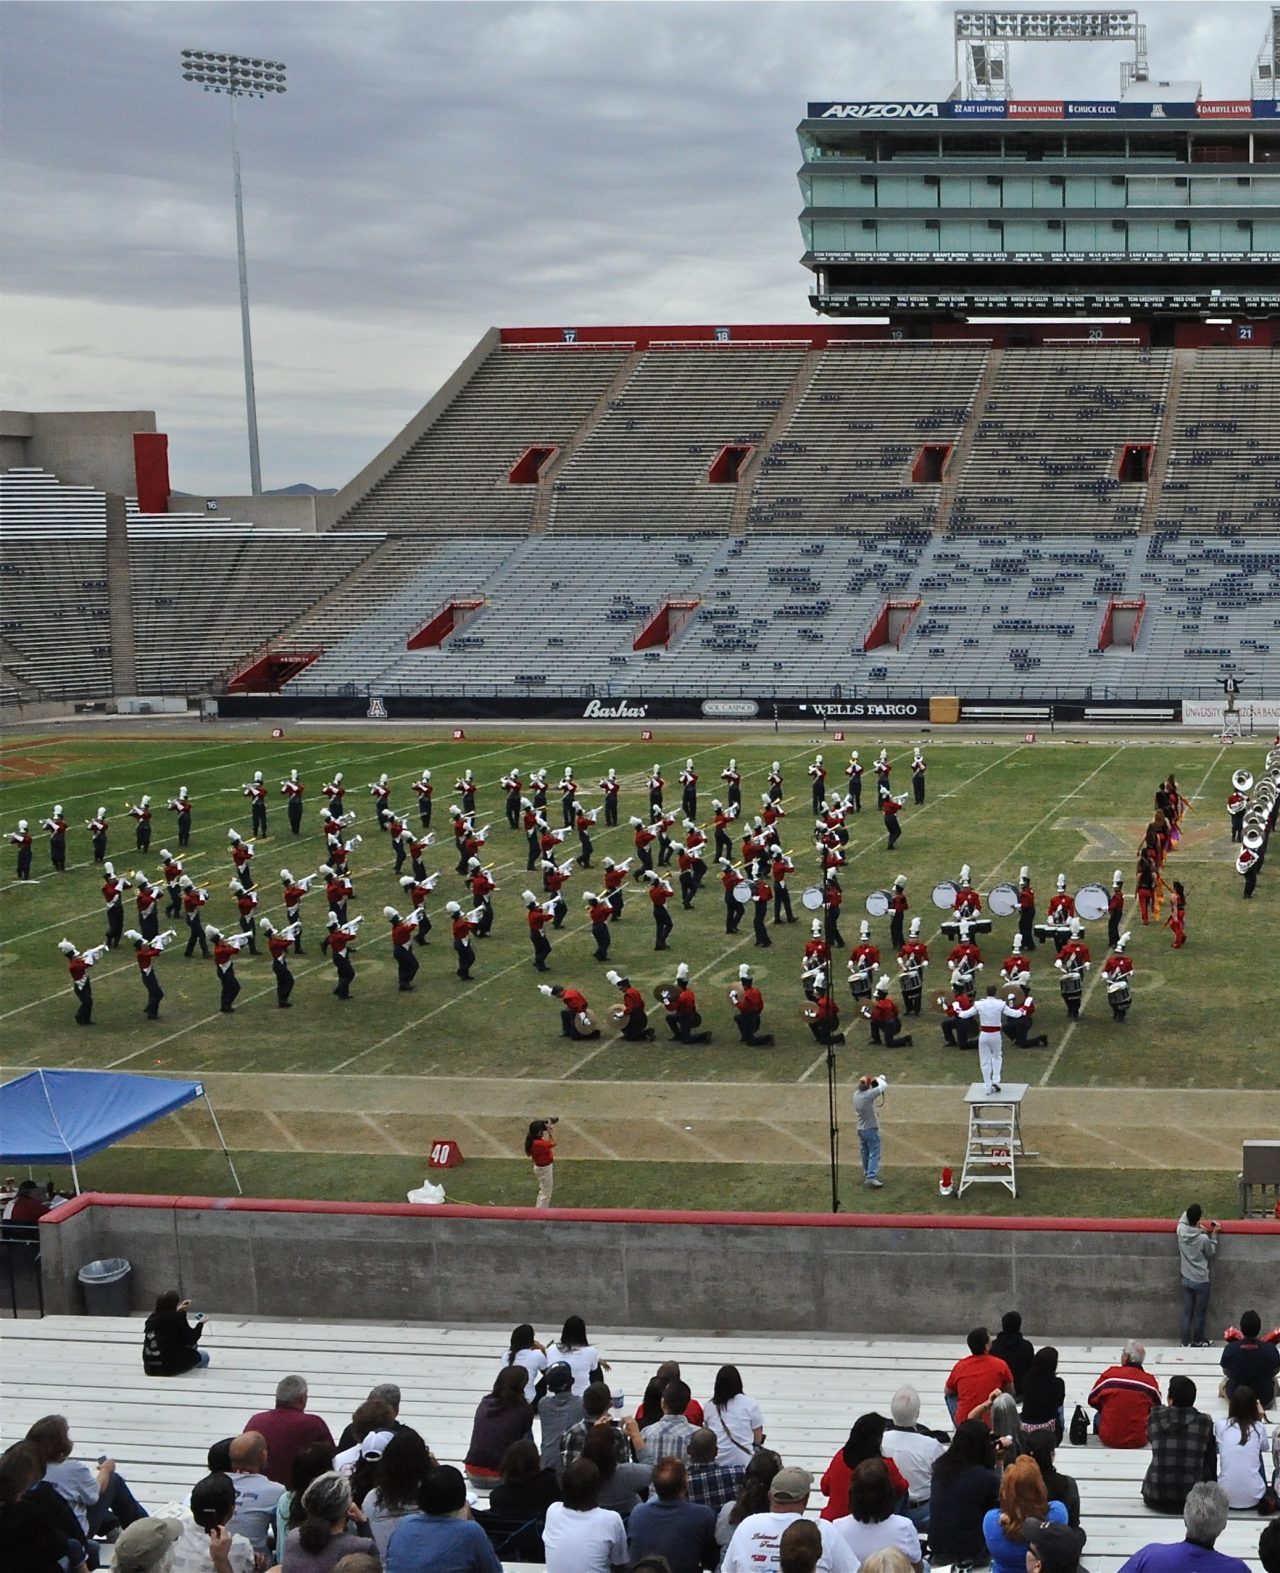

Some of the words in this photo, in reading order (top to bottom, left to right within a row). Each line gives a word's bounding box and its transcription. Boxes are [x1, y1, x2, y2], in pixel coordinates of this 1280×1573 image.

[821, 104, 938, 118] ARIZONA
[954, 104, 962, 113] 22
[1069, 104, 1074, 113] 6
[565, 334, 575, 342] 17
[717, 332, 728, 341] 18
[892, 332, 902, 340] 19
[1089, 330, 1102, 338] 20
[1240, 329, 1251, 339] 21
[207, 501, 216, 510] 16
[584, 700, 648, 718] Bashas'
[812, 704, 864, 716] WELLS
[867, 704, 917, 716] FARGO
[1186, 707, 1220, 717] UNIVERSITY
[1263, 707, 1280, 717] BAND
[431, 1144, 450, 1164] 40
